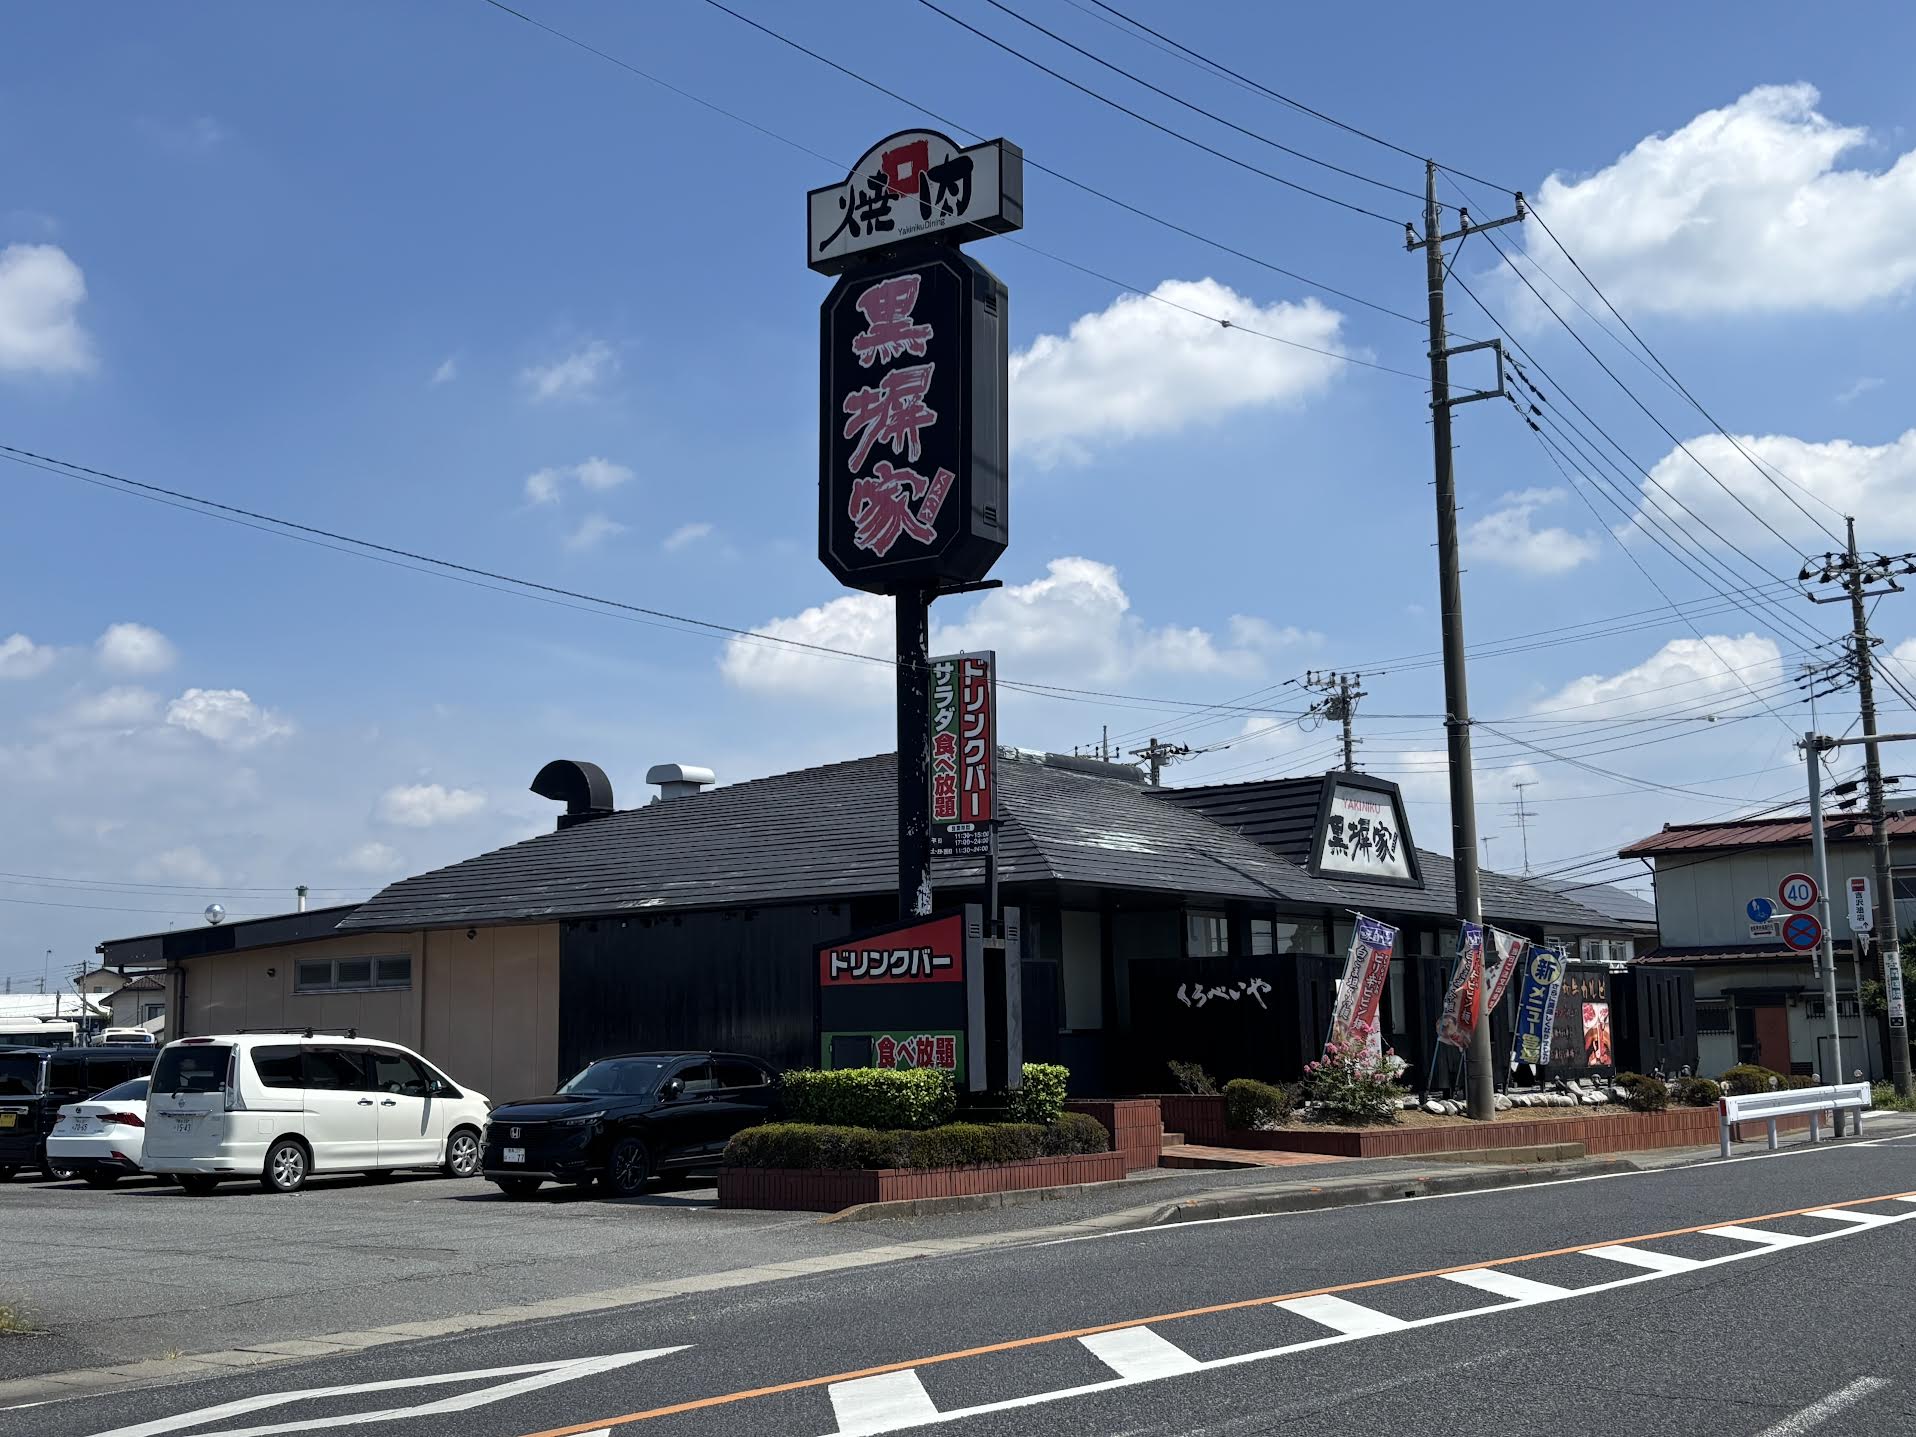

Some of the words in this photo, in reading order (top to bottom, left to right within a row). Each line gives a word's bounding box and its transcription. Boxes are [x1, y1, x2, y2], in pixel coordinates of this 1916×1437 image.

[819, 152, 974, 253] 焼肉
[932, 661, 958, 821] サラダ食べ放題
[963, 660, 986, 817] ドリンクバー
[1343, 798, 1381, 815] YAKINIKU
[1787, 884, 1809, 902] 40
[831, 949, 951, 978] ドリンクバー
[1176, 977, 1272, 1010] くろべいや
[877, 1035, 956, 1069] 食べ放題
